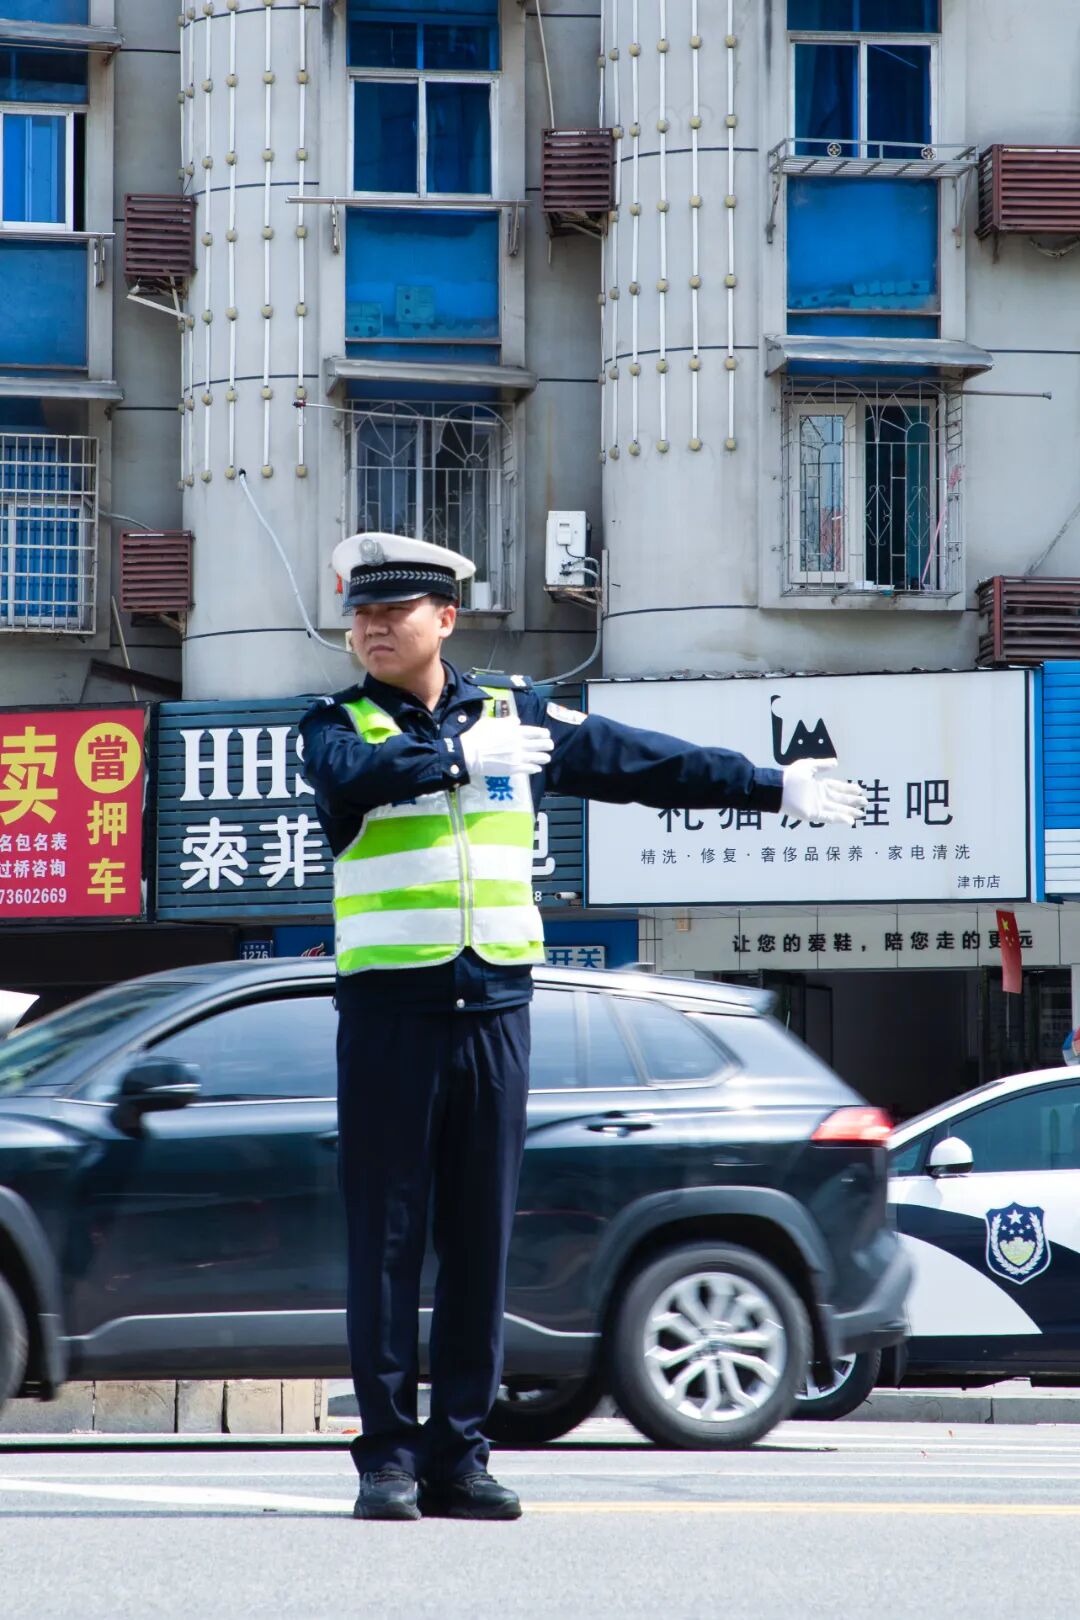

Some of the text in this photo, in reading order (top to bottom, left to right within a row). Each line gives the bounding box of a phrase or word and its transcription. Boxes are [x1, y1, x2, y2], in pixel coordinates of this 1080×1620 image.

[0, 726, 58, 825] 卖
[0, 832, 68, 852] 名包名表
[0, 859, 66, 878] 过桥咨询
[957, 874, 1001, 889] 津市店
[0, 888, 67, 905] 73602669
[242, 950, 269, 960] 1276
[548, 948, 602, 968] 开关
